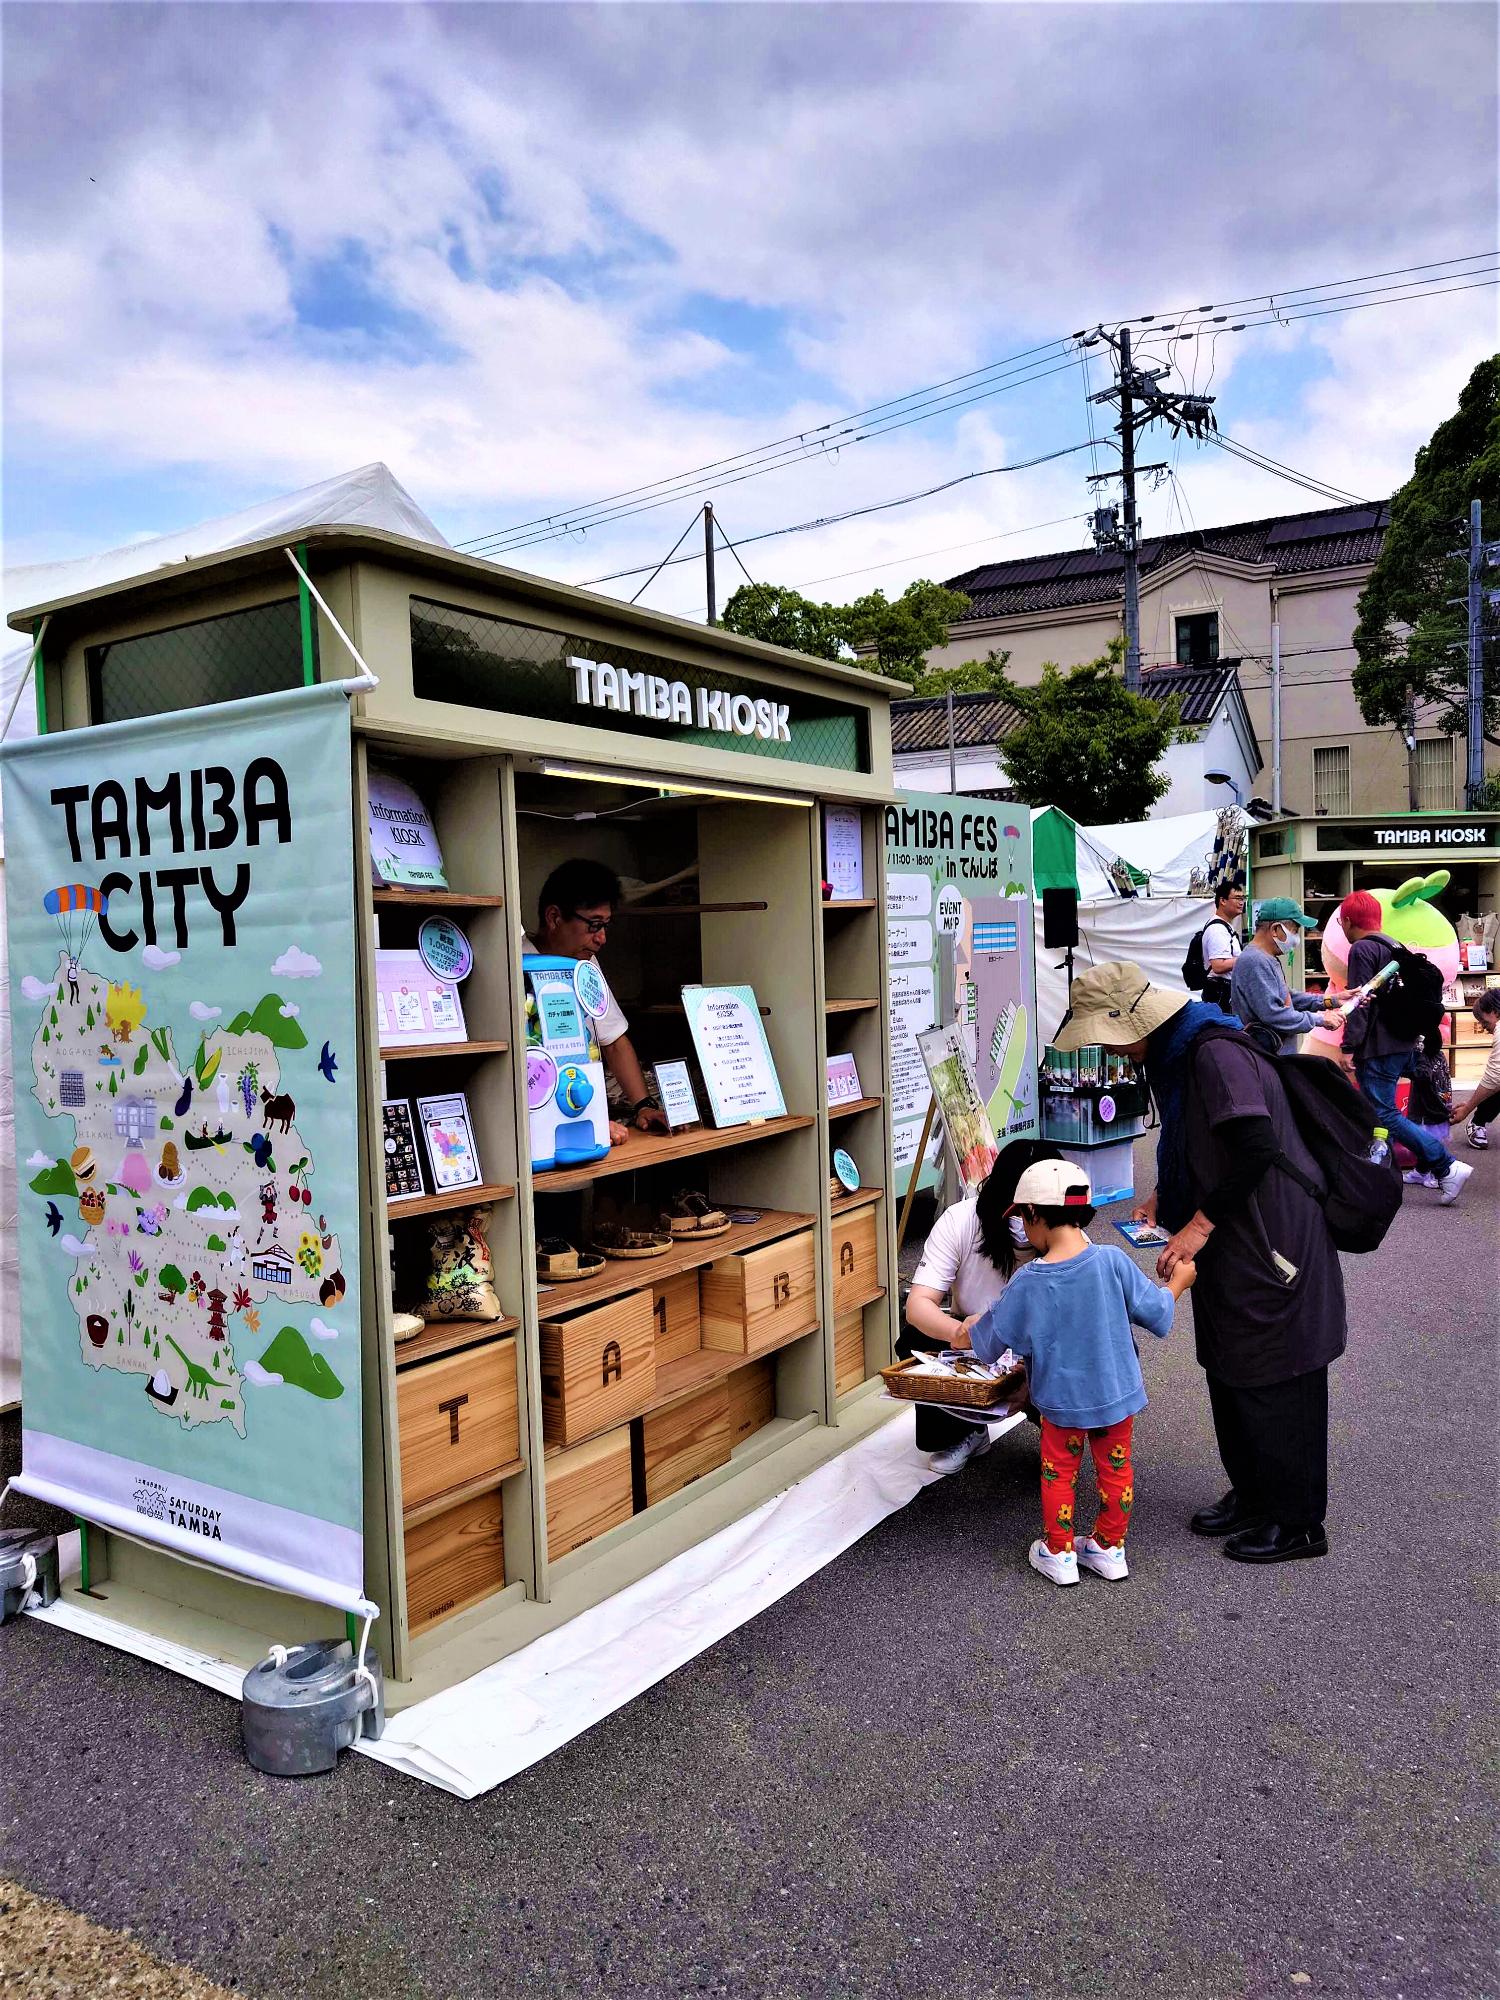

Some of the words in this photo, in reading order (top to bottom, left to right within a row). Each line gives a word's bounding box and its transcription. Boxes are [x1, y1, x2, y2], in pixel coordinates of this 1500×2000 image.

[566, 655, 693, 725] TAMBA
[696, 687, 792, 742] KIOSK
[50, 756, 292, 863] TAMBA
[368, 800, 428, 825] Information
[390, 826, 425, 846] KIOSK
[960, 814, 998, 853] FES
[1374, 829, 1431, 844] TAMBA
[1434, 828, 1486, 843] KIOSK
[892, 853, 911, 865] 11:00
[916, 854, 934, 866] 18:00
[946, 855, 957, 878] in
[959, 856, 998, 879] てんしば
[98, 862, 251, 953] CITY
[939, 901, 962, 915] EVENT
[943, 916, 960, 931] MAP
[535, 972, 560, 981] TAMBA
[561, 971, 573, 980] FES
[707, 1002, 740, 1012] Information
[840, 1240, 855, 1277] A
[773, 1271, 790, 1310] B
[601, 1340, 623, 1389] A
[438, 1393, 469, 1446] T
[169, 1496, 222, 1522] SATURDAY
[168, 1509, 222, 1542] TAMBA
